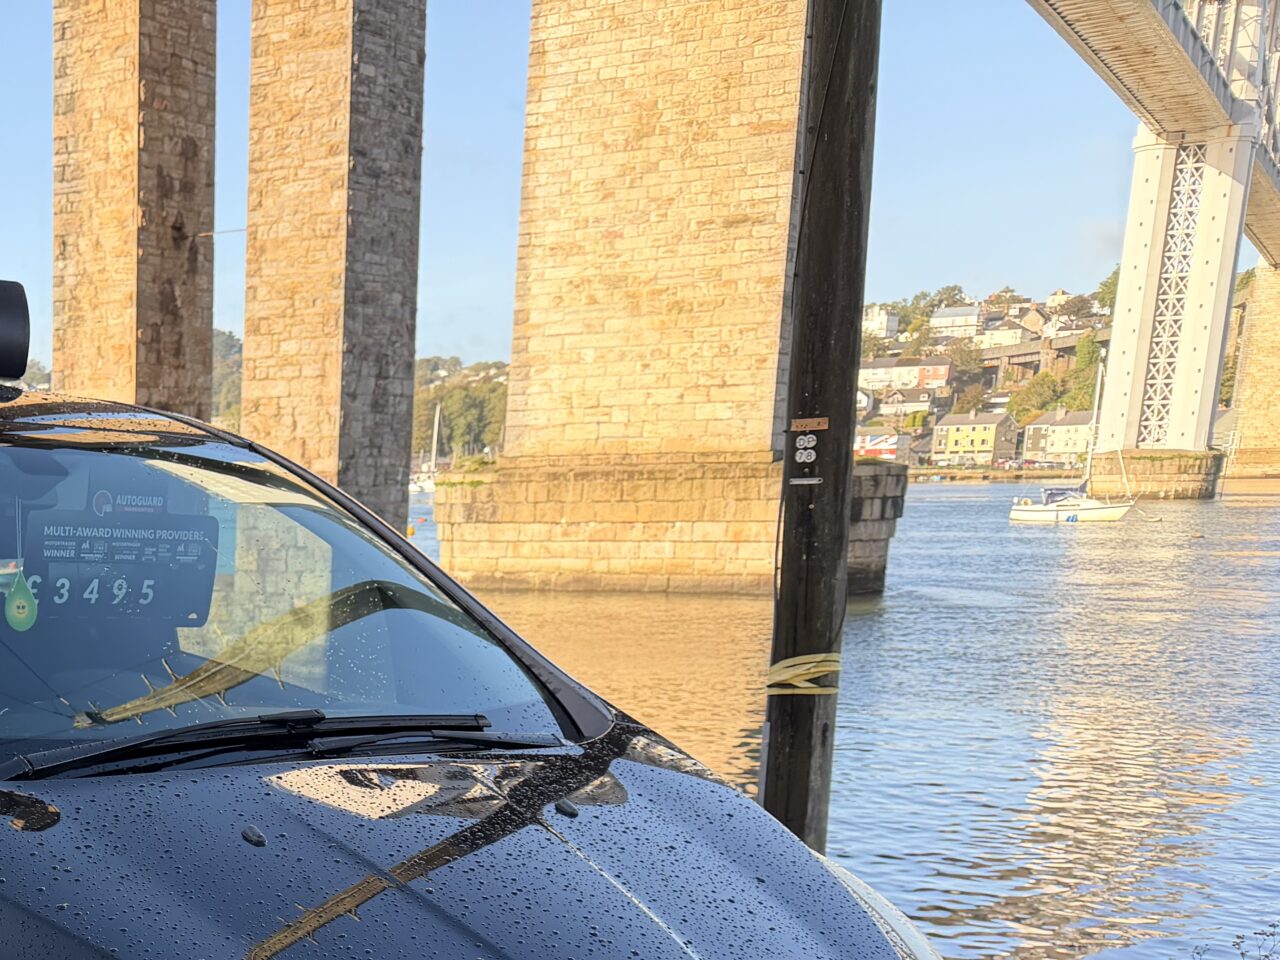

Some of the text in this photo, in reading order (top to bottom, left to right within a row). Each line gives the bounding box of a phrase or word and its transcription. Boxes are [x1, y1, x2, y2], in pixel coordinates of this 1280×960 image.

[115, 494, 164, 506] AUTOGUARD
[43, 525, 204, 541] MULTI-AWARD WINNING PROVIDERS
[43, 548, 76, 558] WINNER
